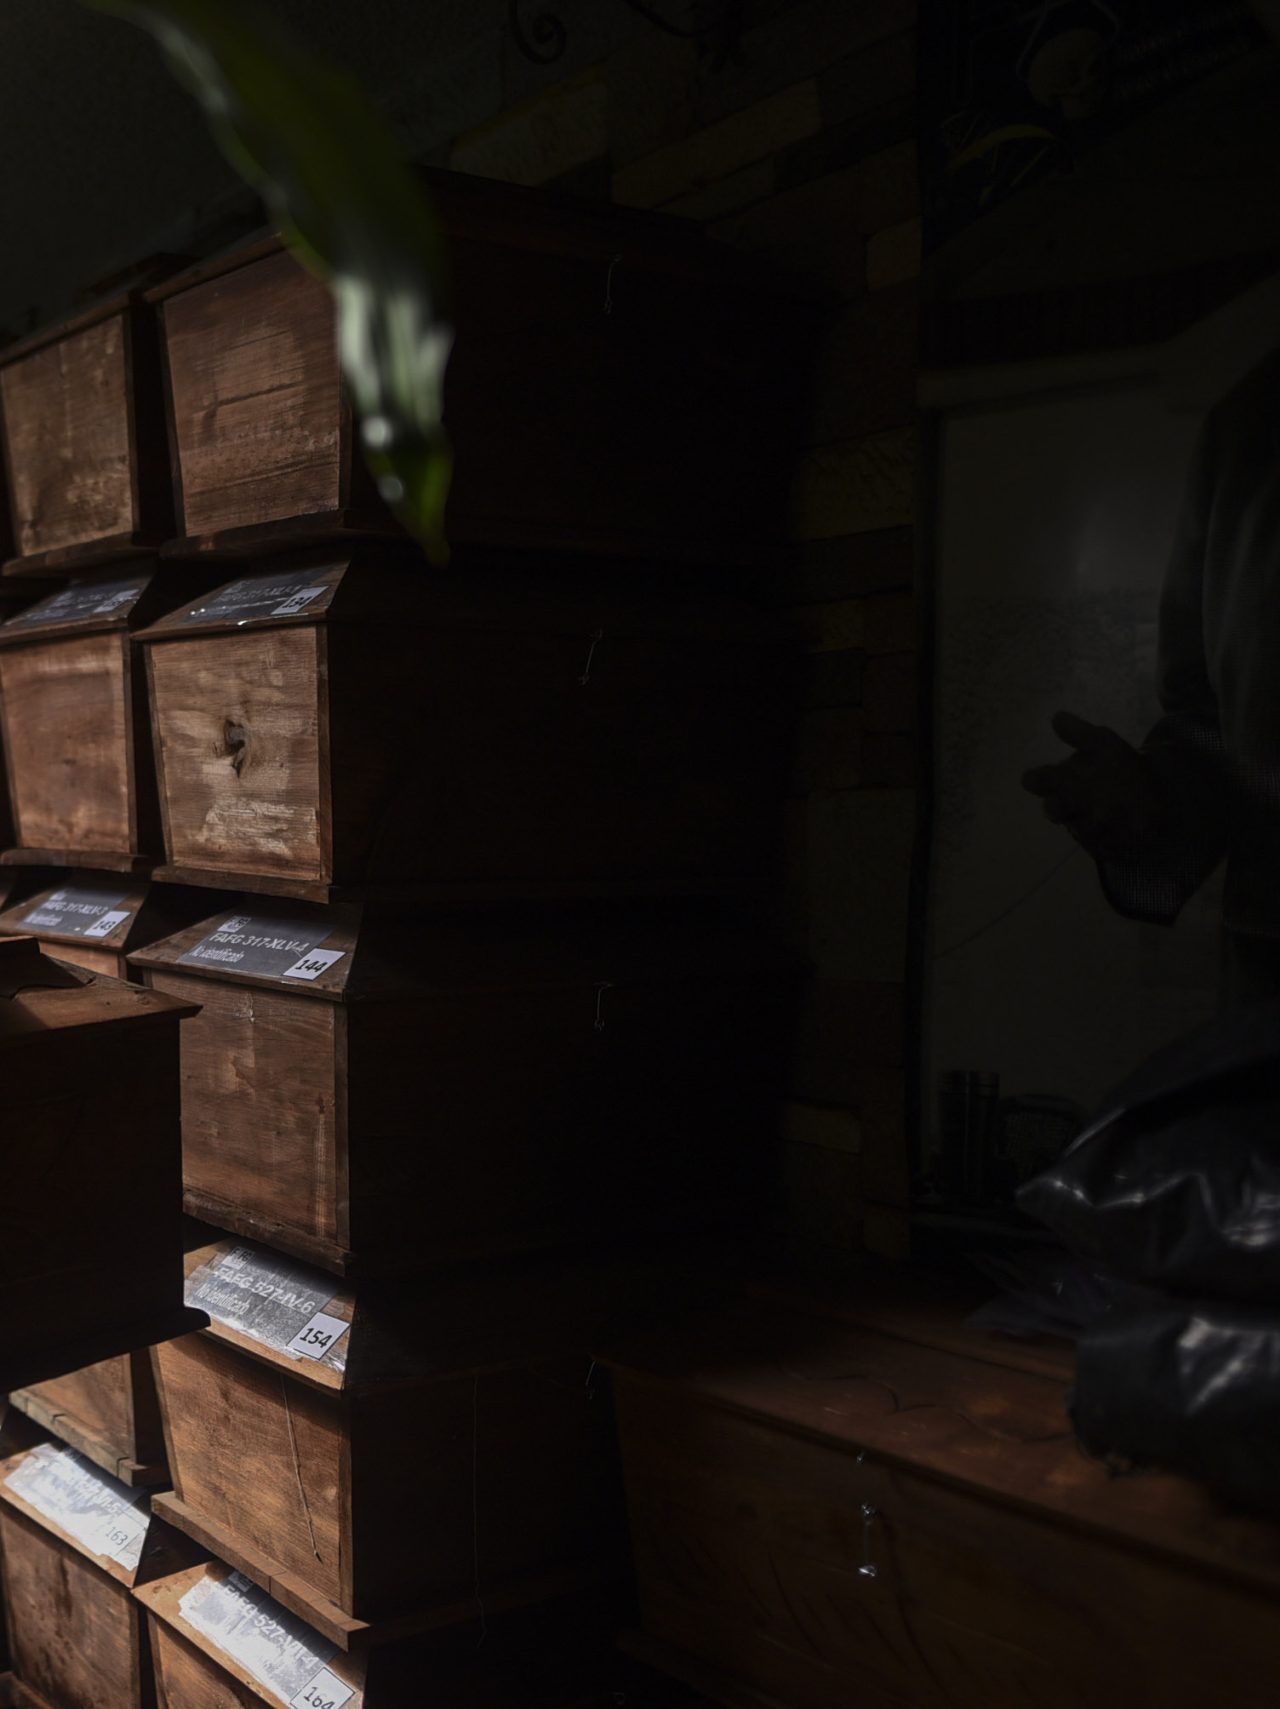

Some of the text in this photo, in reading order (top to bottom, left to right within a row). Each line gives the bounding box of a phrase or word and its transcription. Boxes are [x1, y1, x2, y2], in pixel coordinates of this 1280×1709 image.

[209, 933, 245, 944] FAFG
[296, 959, 327, 973] 144
[300, 1327, 333, 1348] 154
[105, 1526, 128, 1546] 163
